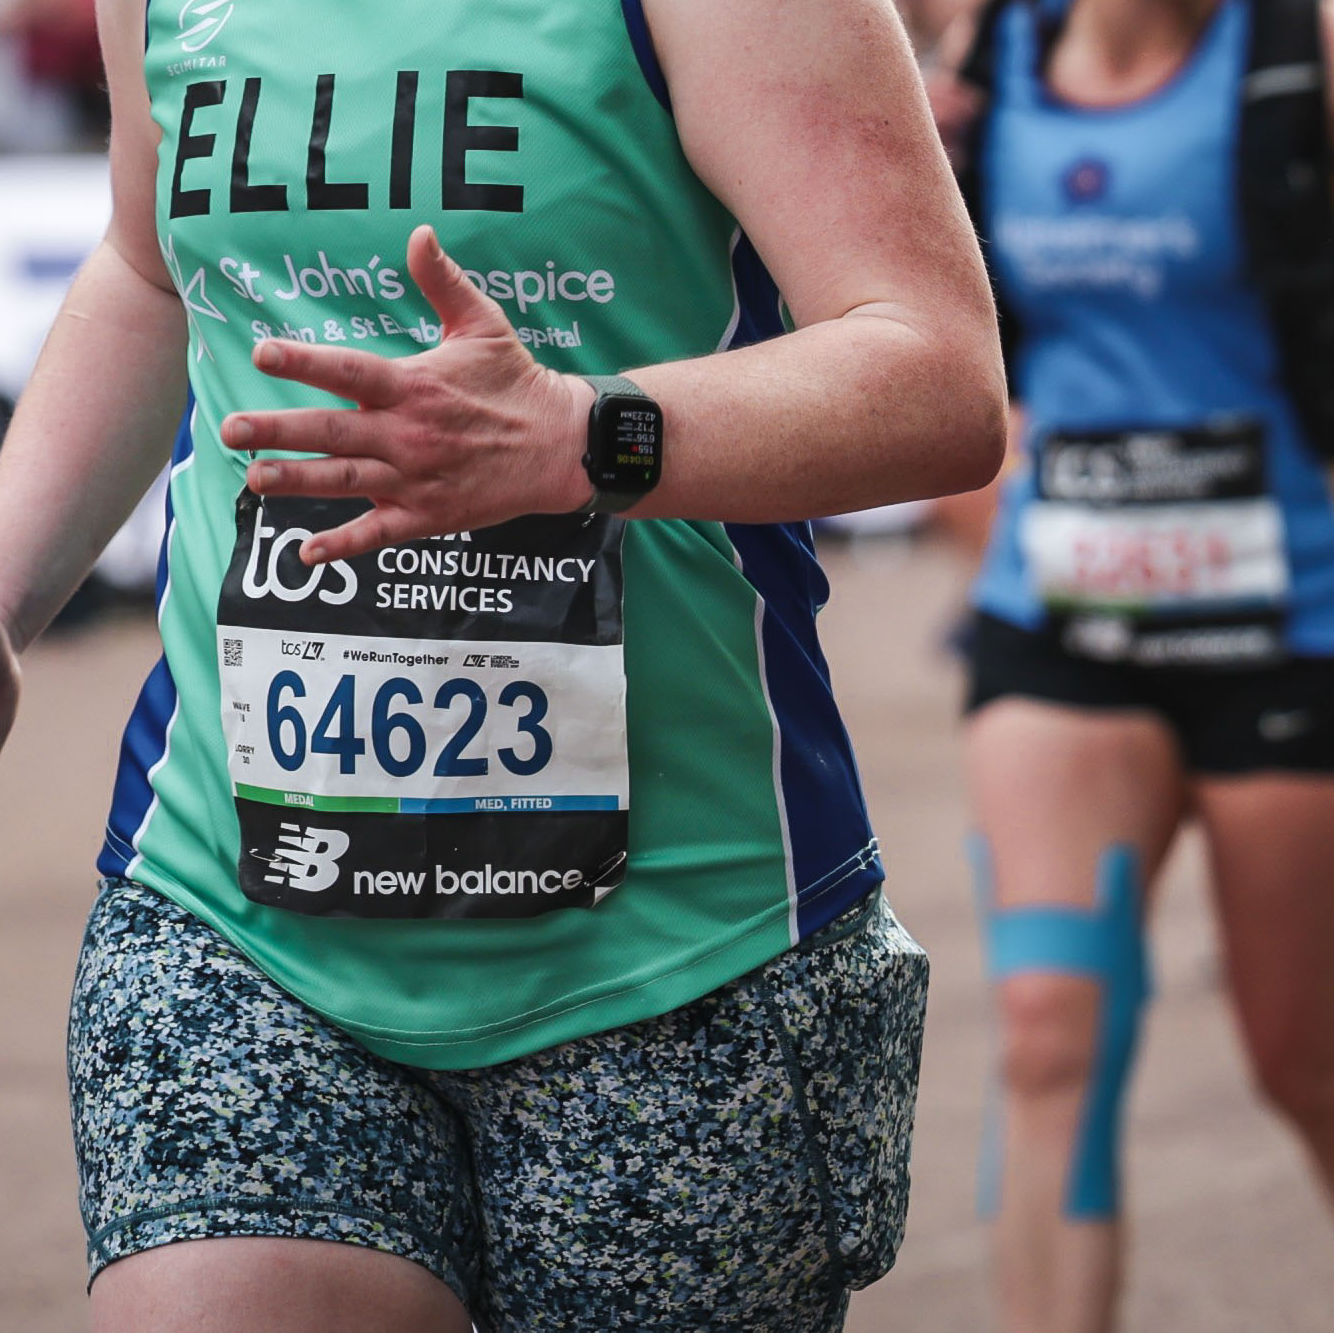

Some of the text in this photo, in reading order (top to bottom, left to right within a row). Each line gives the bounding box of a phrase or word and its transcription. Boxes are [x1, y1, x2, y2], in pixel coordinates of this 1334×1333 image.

[168, 55, 227, 76] SCIMITAR
[169, 70, 524, 219] ELLIE
[219, 250, 615, 313] St John's ospice
[323, 319, 347, 342] &
[351, 316, 379, 340] St
[242, 506, 358, 605] tcs
[377, 547, 596, 583] CONSULTANCY
[375, 582, 514, 613] SERVICES
[281, 639, 301, 656] tcs
[343, 650, 449, 667] #WeRunTogether
[267, 669, 554, 778] 64623
[284, 793, 315, 807] MEDAL
[475, 798, 553, 811] MED, FITTED
[353, 864, 584, 895] new balance
